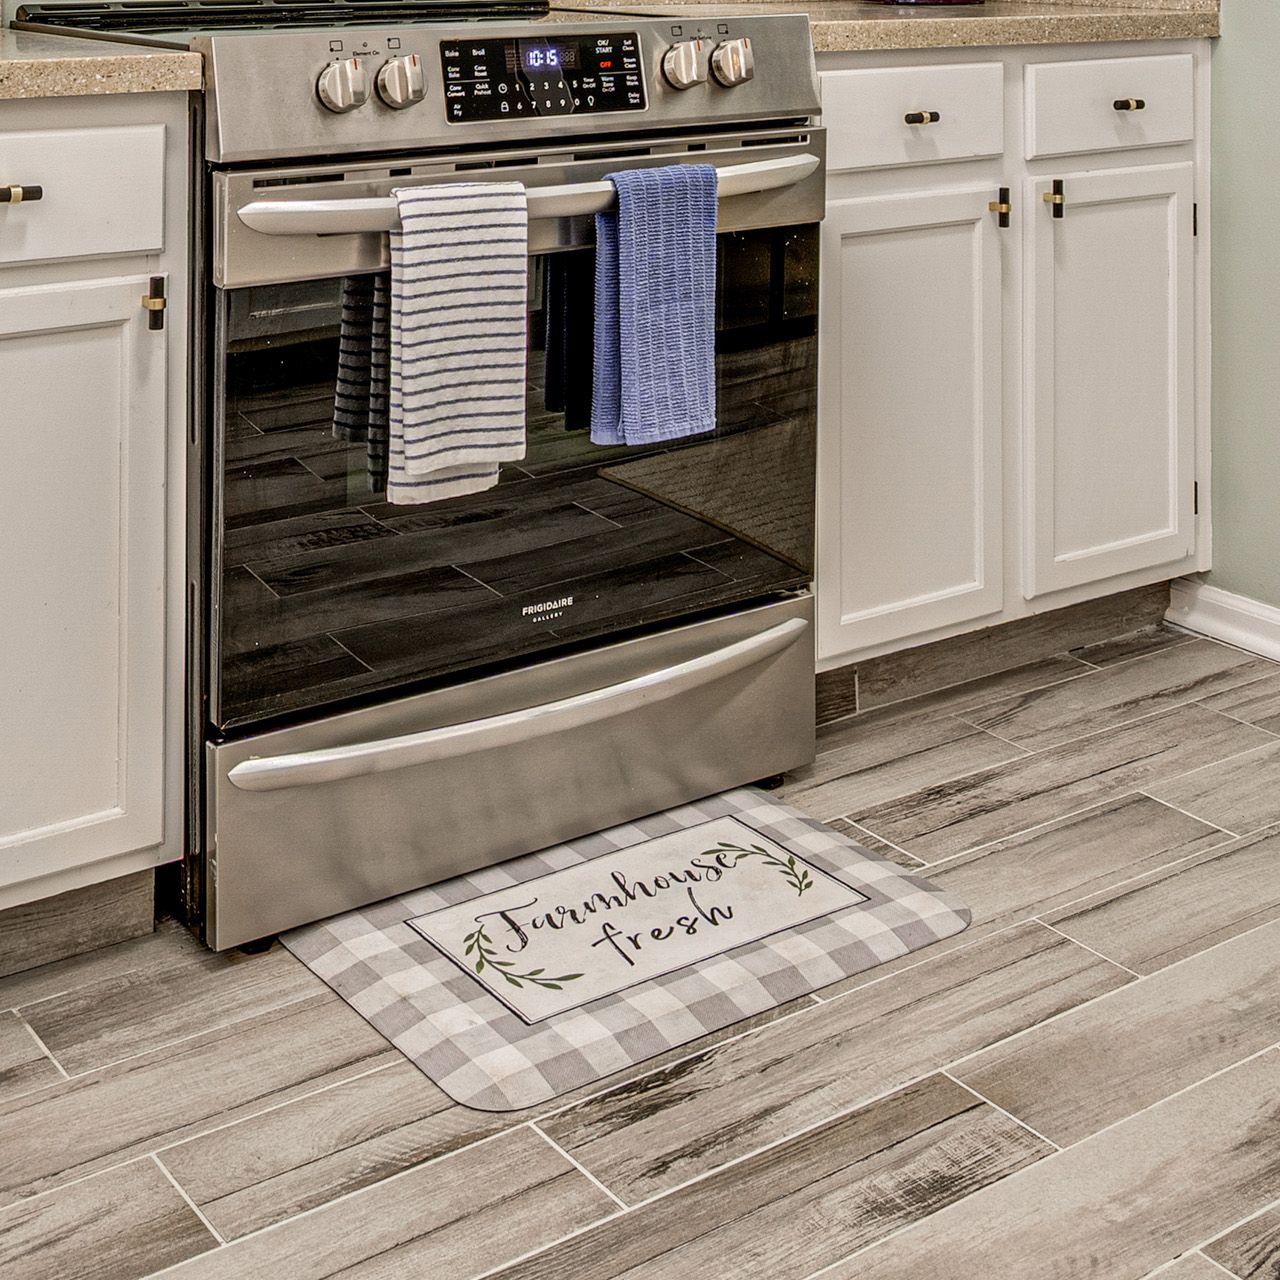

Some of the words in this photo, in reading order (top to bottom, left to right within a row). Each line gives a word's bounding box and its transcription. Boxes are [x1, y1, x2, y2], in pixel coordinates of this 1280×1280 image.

[445, 49, 459, 57] Bake
[472, 48, 485, 56] Broil
[595, 46, 613, 54] START
[529, 49, 558, 67] 10:15
[529, 83, 535, 91] 2
[543, 82, 549, 90] 3
[558, 81, 563, 89] 4
[572, 80, 578, 88] 5
[517, 102, 522, 110] 6
[531, 101, 536, 109] 7
[546, 100, 551, 108] 8
[560, 99, 565, 107] 9
[522, 596, 573, 616] FRIGIDAIRE
[532, 611, 563, 623] GALLERY
[474, 852, 737, 953] Farmhouse
[590, 886, 734, 967] fresh
